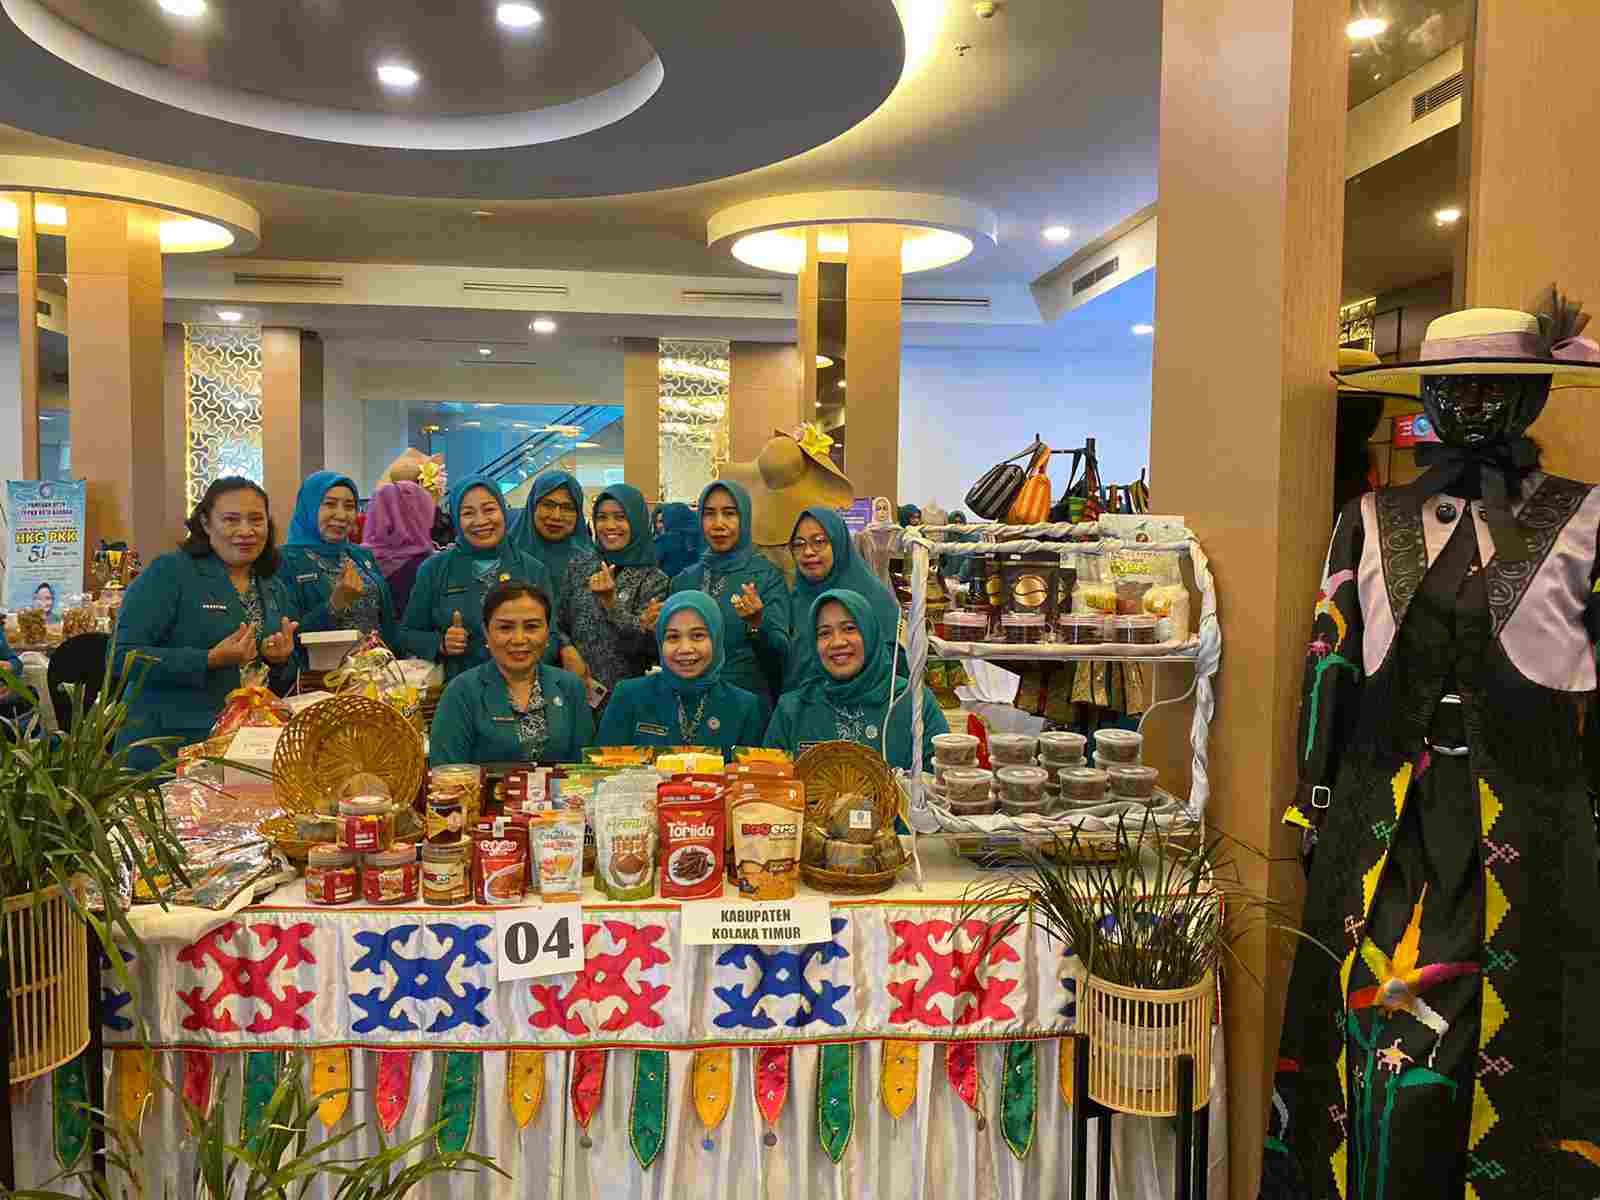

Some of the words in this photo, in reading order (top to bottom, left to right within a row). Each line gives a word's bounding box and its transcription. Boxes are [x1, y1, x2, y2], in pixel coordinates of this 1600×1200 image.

[16, 531, 46, 544] HKG
[720, 909, 791, 923] KABUPATEN
[712, 927, 759, 940] KOLAKA
[762, 926, 801, 940] TIMUR
[505, 917, 574, 964] 04
